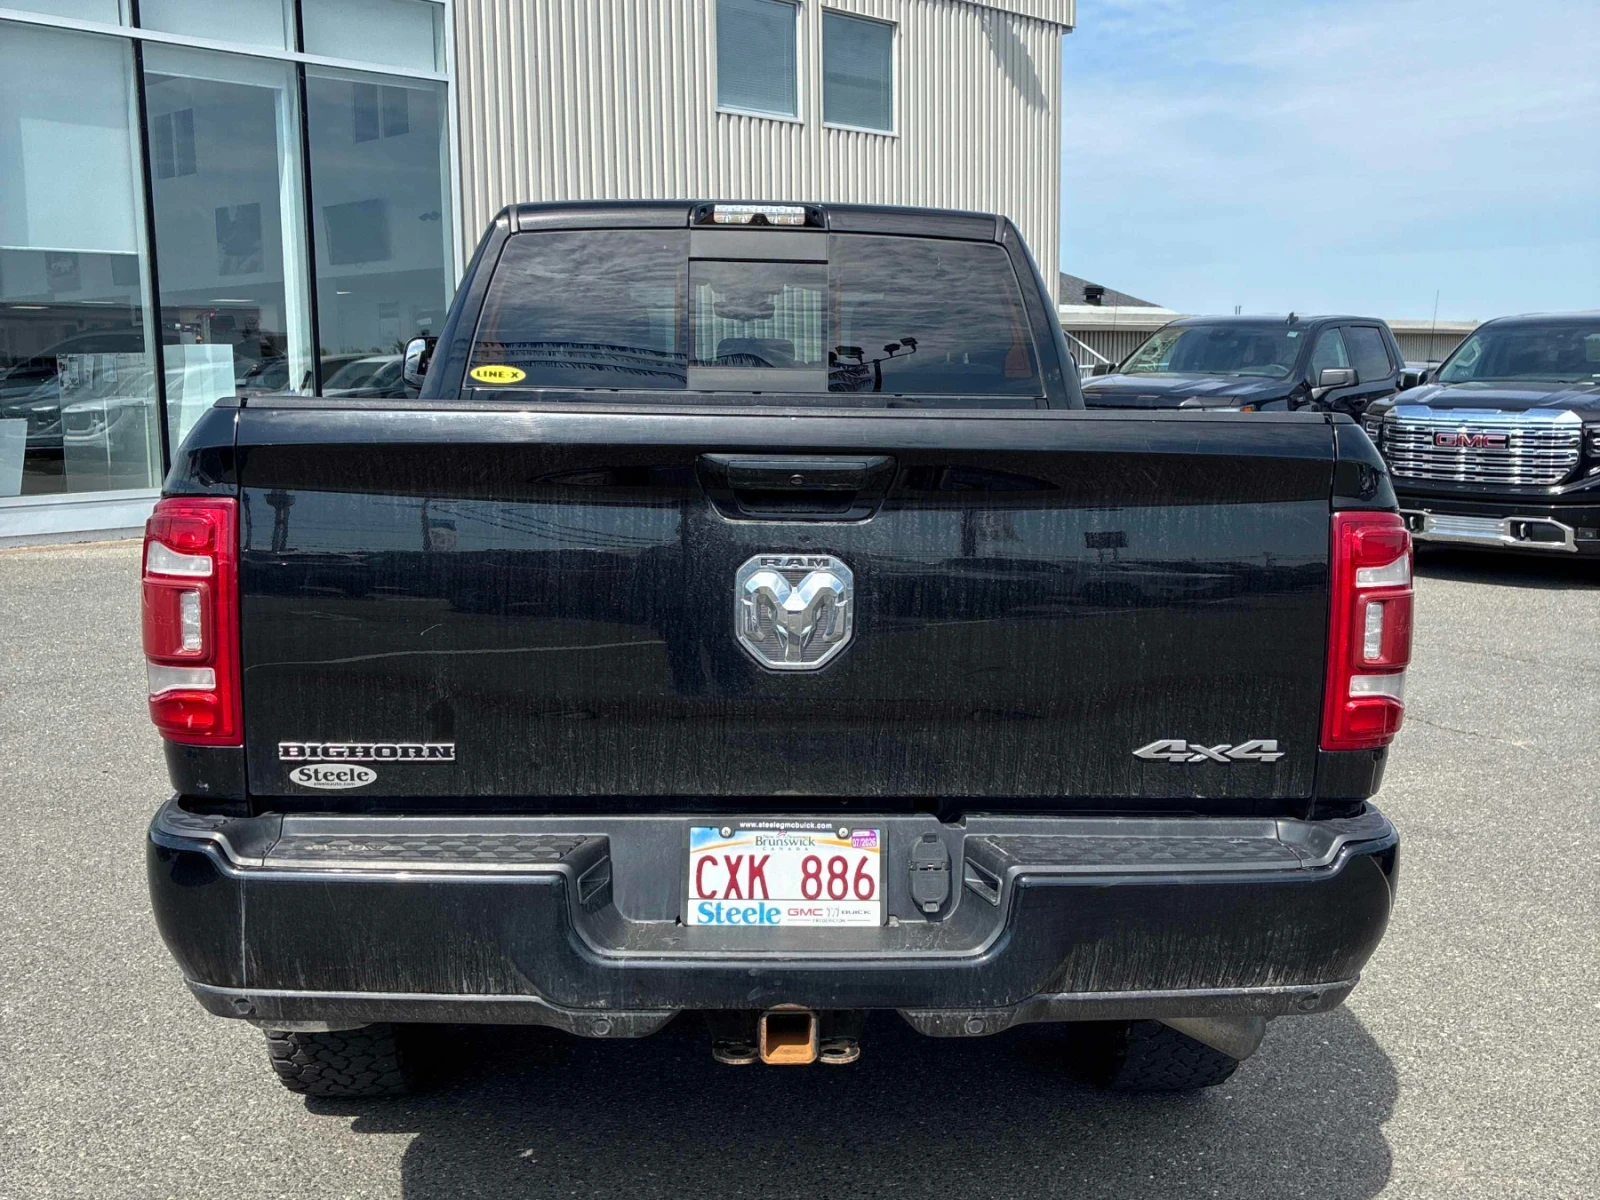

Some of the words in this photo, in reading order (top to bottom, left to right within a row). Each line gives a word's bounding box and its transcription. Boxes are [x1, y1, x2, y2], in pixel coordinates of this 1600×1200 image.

[1436, 433, 1507, 449] GMC
[760, 558, 830, 567] RAM
[278, 742, 456, 761] BIGHORN
[298, 768, 370, 782] Steele
[739, 821, 832, 830] www.steelegmcbuick.com
[755, 835, 816, 847] Brunswick
[695, 855, 770, 900] CXK
[800, 855, 875, 900] 886
[697, 901, 781, 924] Steele
[787, 907, 823, 917] GMC
